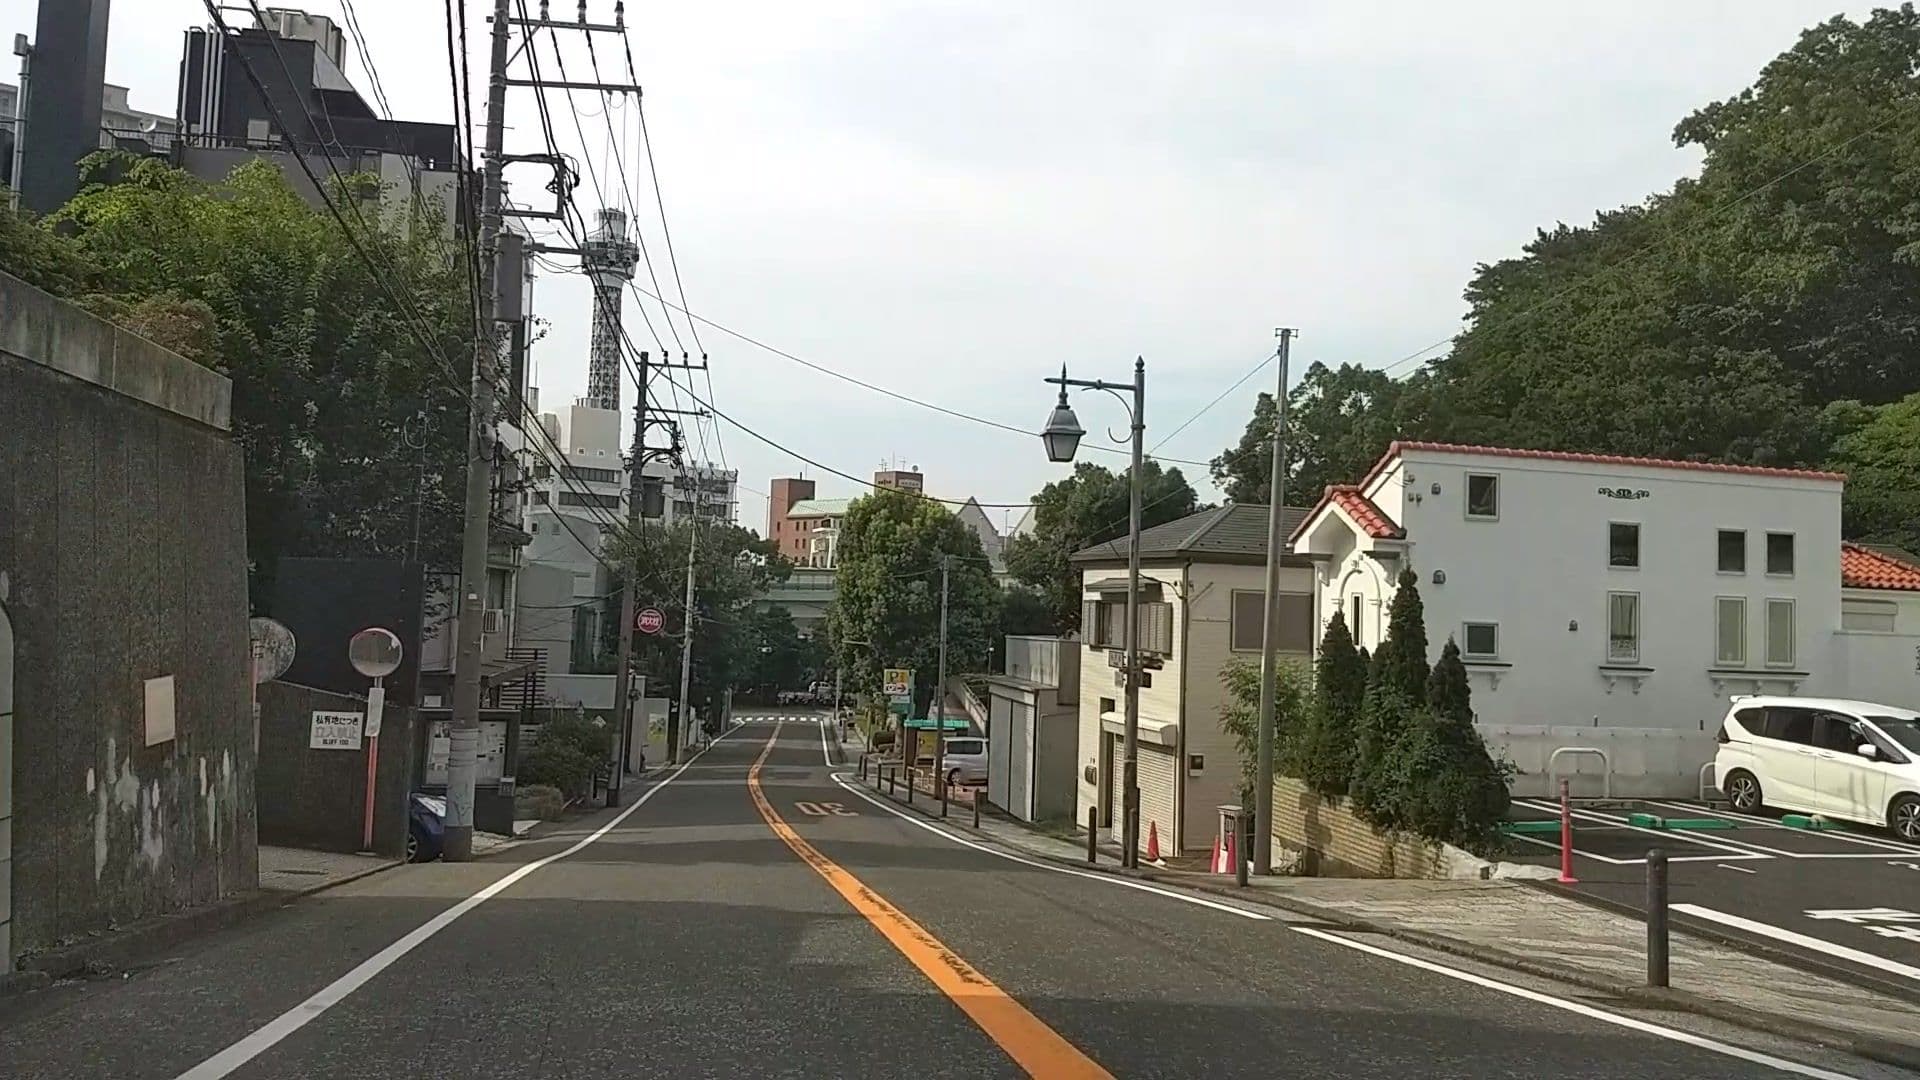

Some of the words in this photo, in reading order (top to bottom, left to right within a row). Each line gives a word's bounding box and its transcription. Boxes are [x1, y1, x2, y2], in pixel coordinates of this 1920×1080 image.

[315, 714, 359, 726] 私有地につき
[314, 725, 358, 739] 立入止
